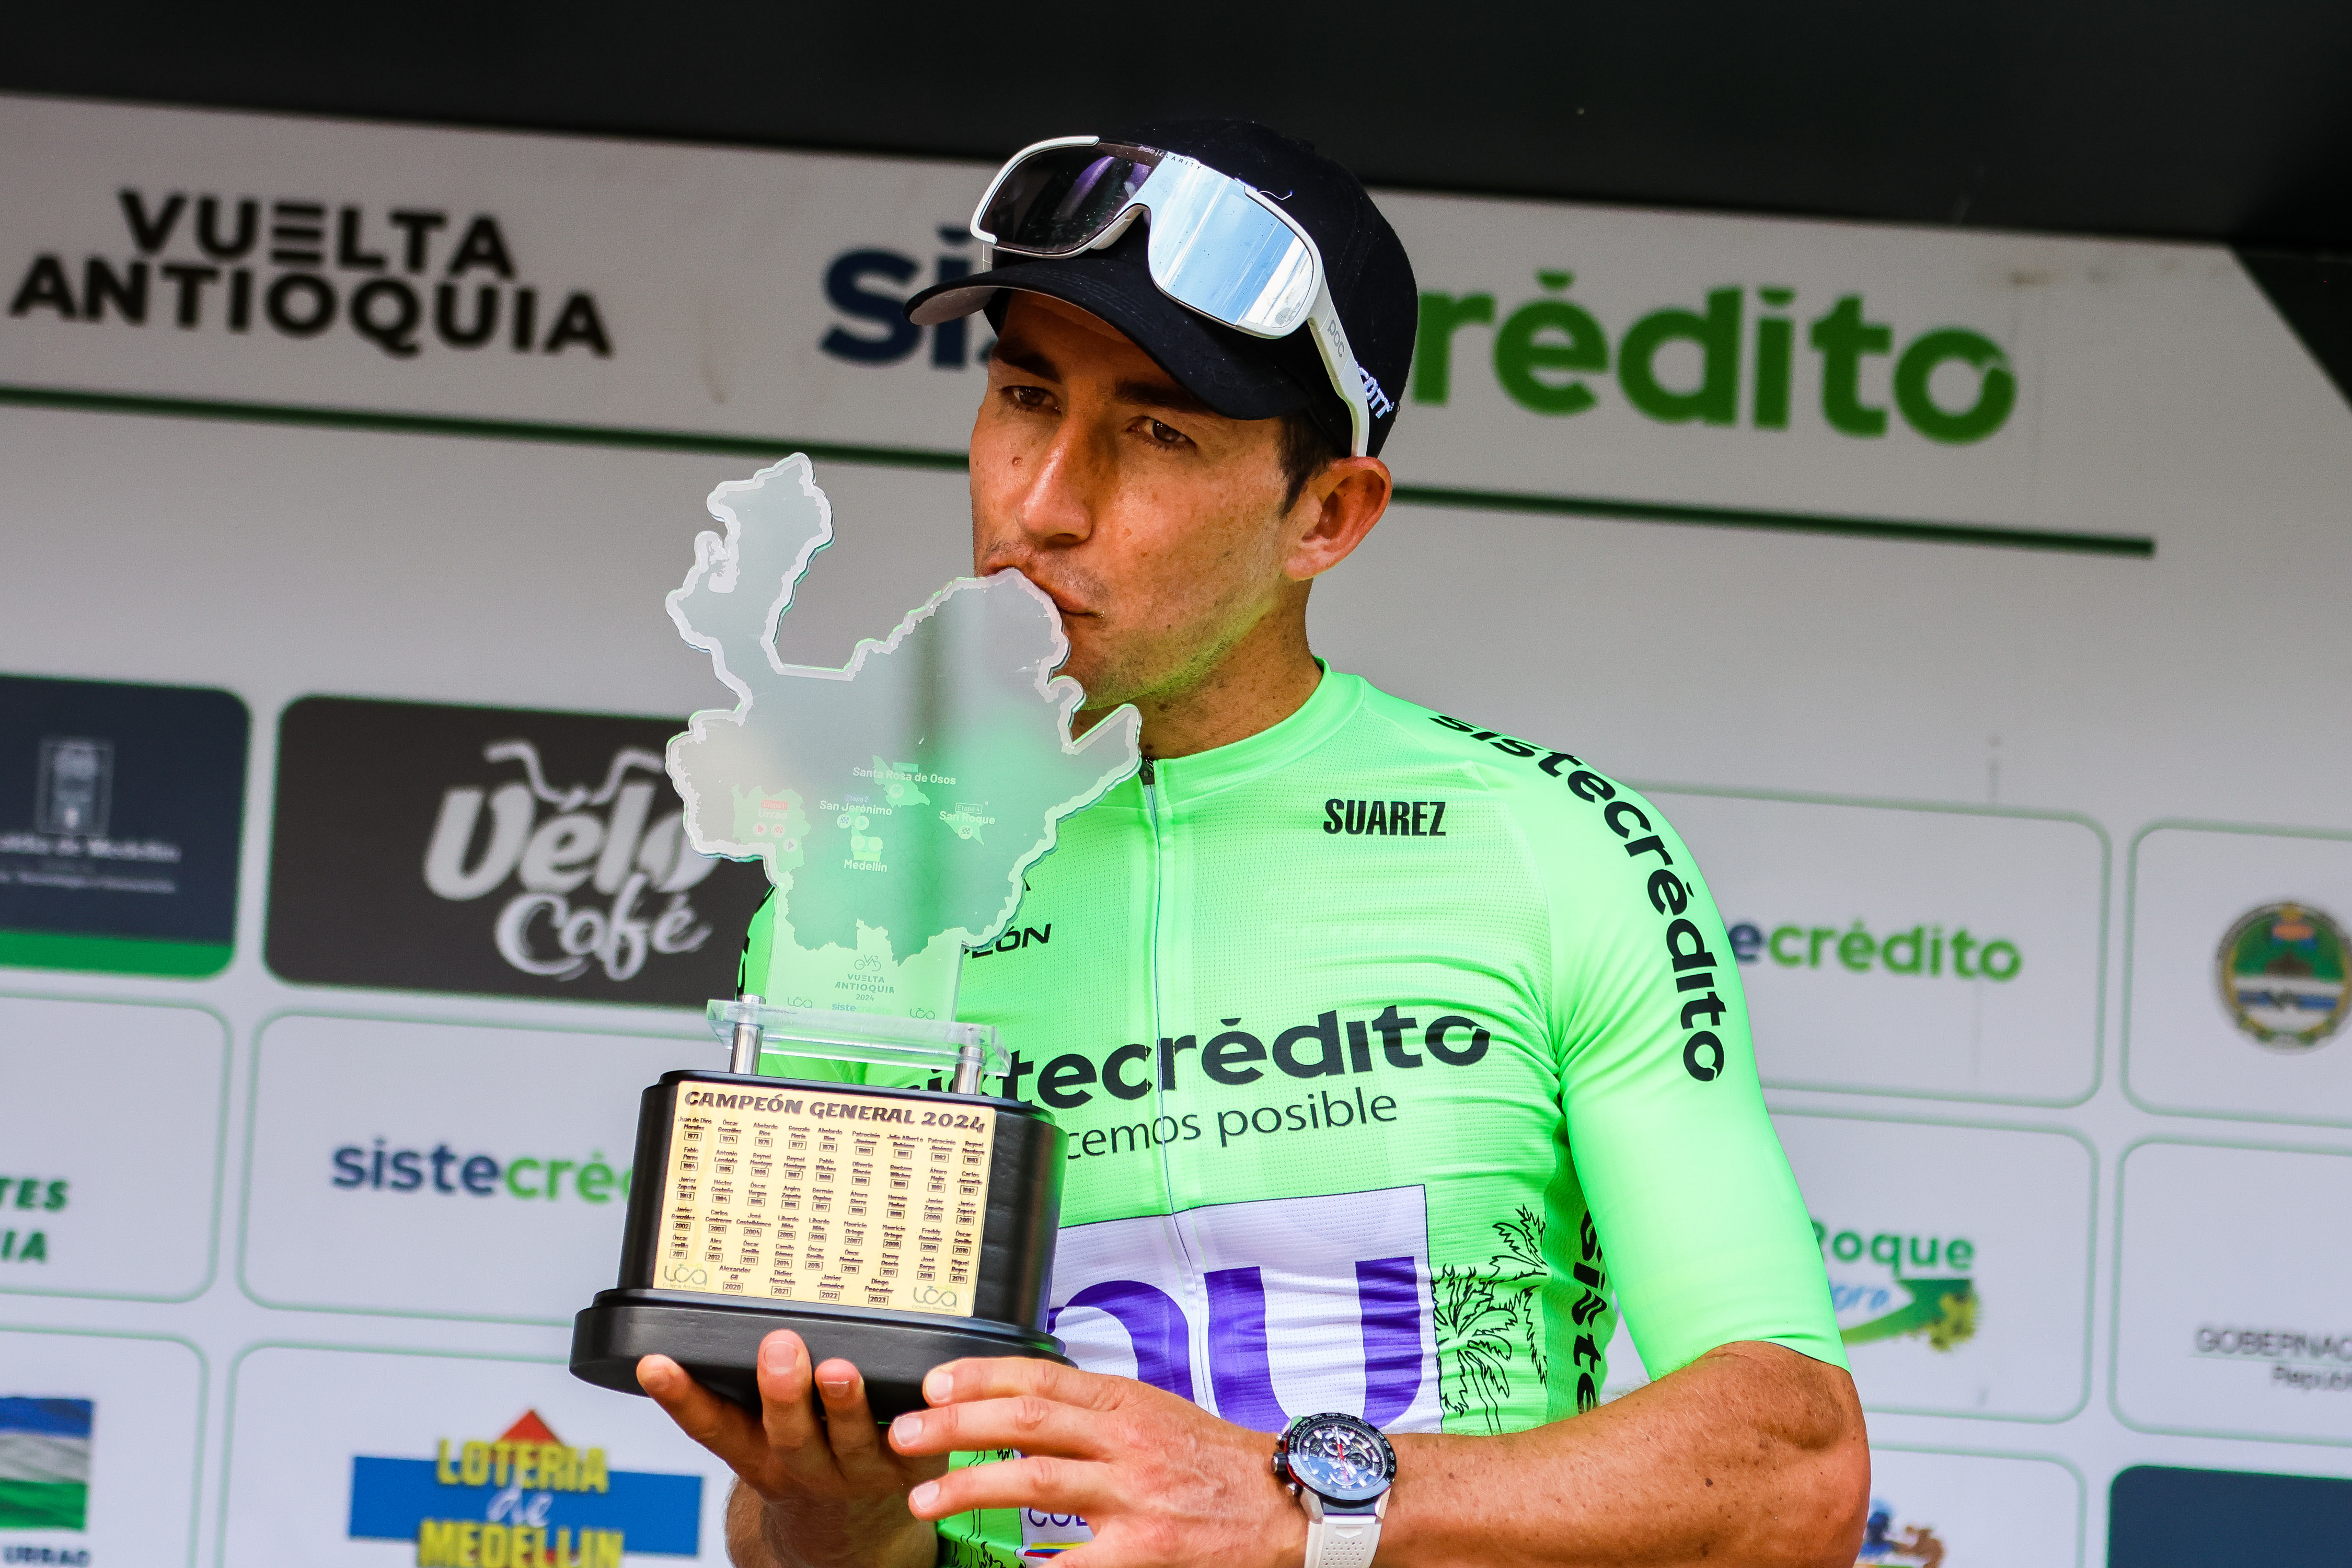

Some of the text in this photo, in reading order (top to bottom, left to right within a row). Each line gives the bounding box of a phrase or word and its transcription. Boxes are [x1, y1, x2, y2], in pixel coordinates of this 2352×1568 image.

[117, 187, 517, 281] VUELTA
[10, 252, 615, 361] ANTIOQUIA
[852, 767, 956, 785] Santa Rosa de Osos
[846, 794, 863, 803] Etapa
[819, 800, 892, 816] San Jerónimo
[939, 811, 996, 826] San Roque
[1323, 798, 1446, 837] SUAREZ
[844, 859, 888, 872] Medellín
[1728, 917, 2023, 983] ecrédito
[847, 973, 885, 984] VUELTA
[835, 982, 895, 994] ANTIOQUIA
[855, 994, 874, 1002] 2024
[685, 1091, 986, 1134] CAMPEÓN GENERAL 2024
[1067, 1087, 1398, 1161] cemos posible
[332, 1137, 632, 1204] sistecré
